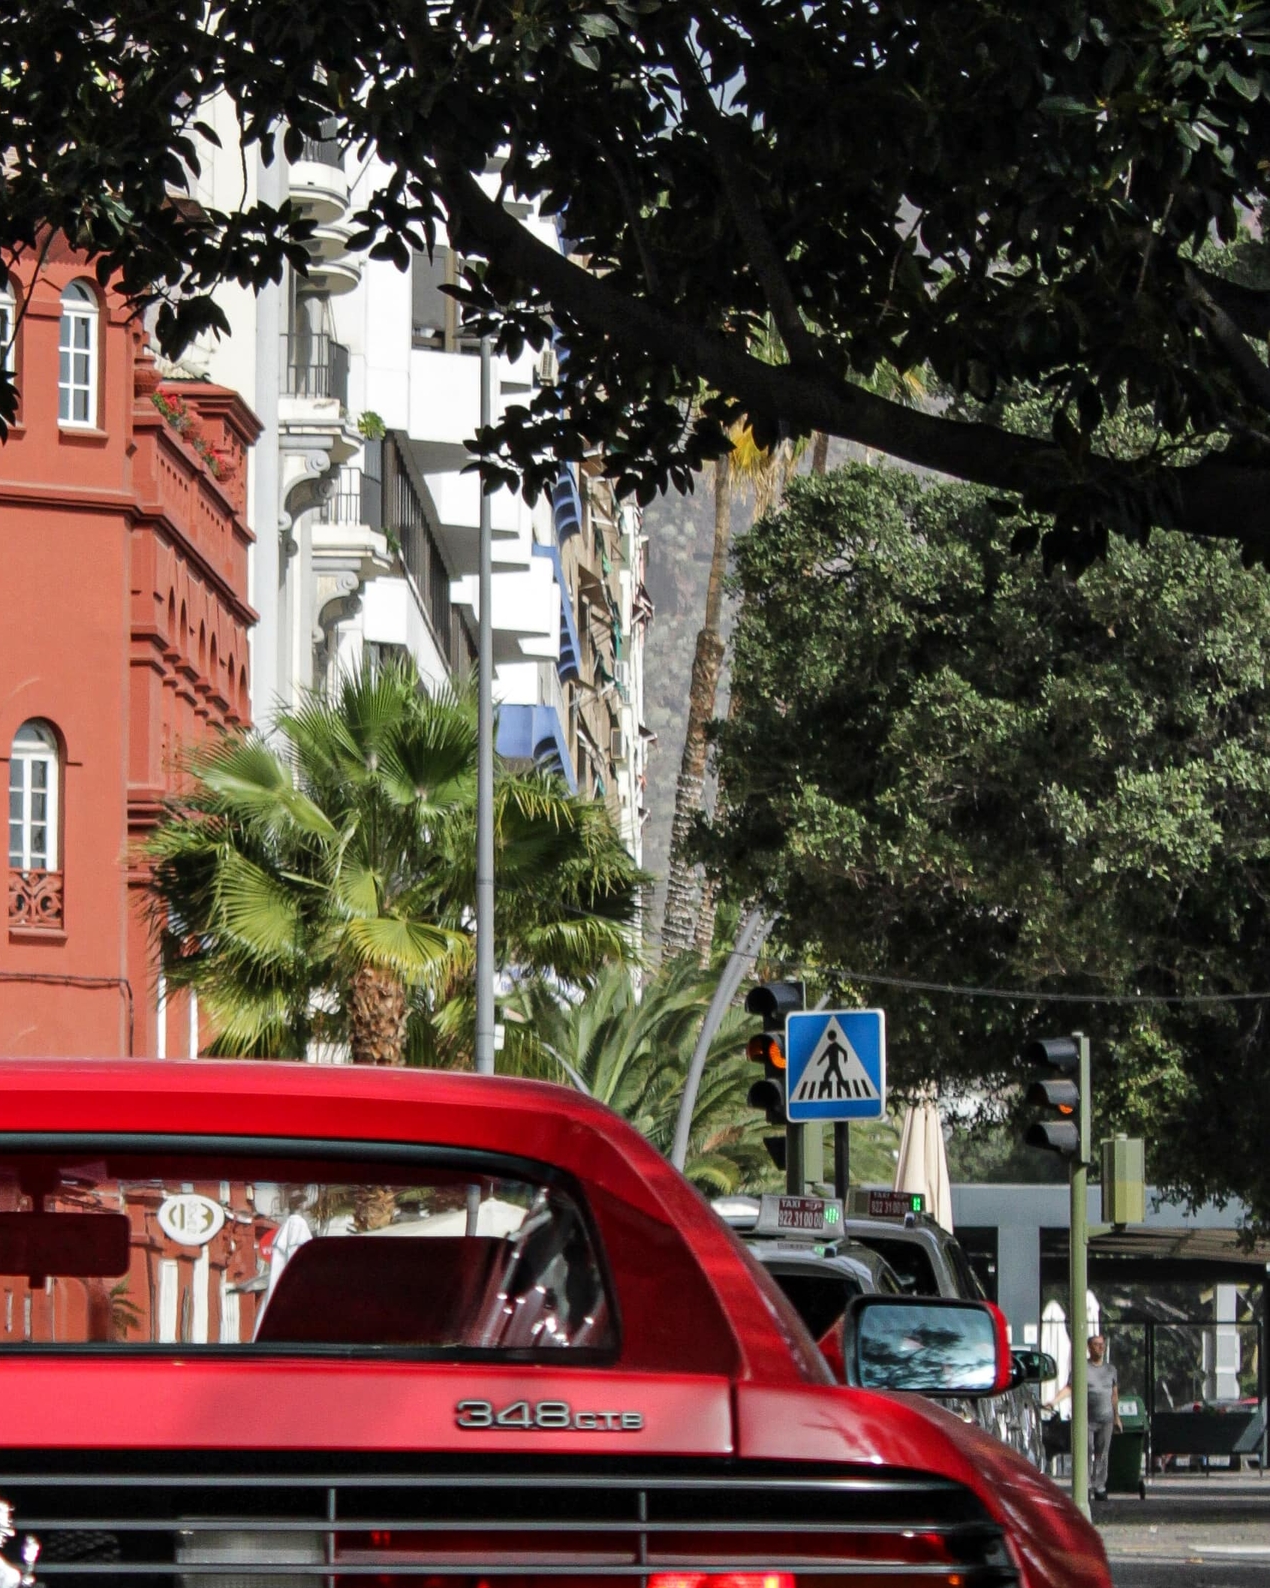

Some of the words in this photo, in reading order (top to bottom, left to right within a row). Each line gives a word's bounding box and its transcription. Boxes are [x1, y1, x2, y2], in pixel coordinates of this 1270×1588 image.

[781, 1199, 801, 1208] TAXI
[779, 1209, 793, 1226] 922
[794, 1210, 803, 1227] 31
